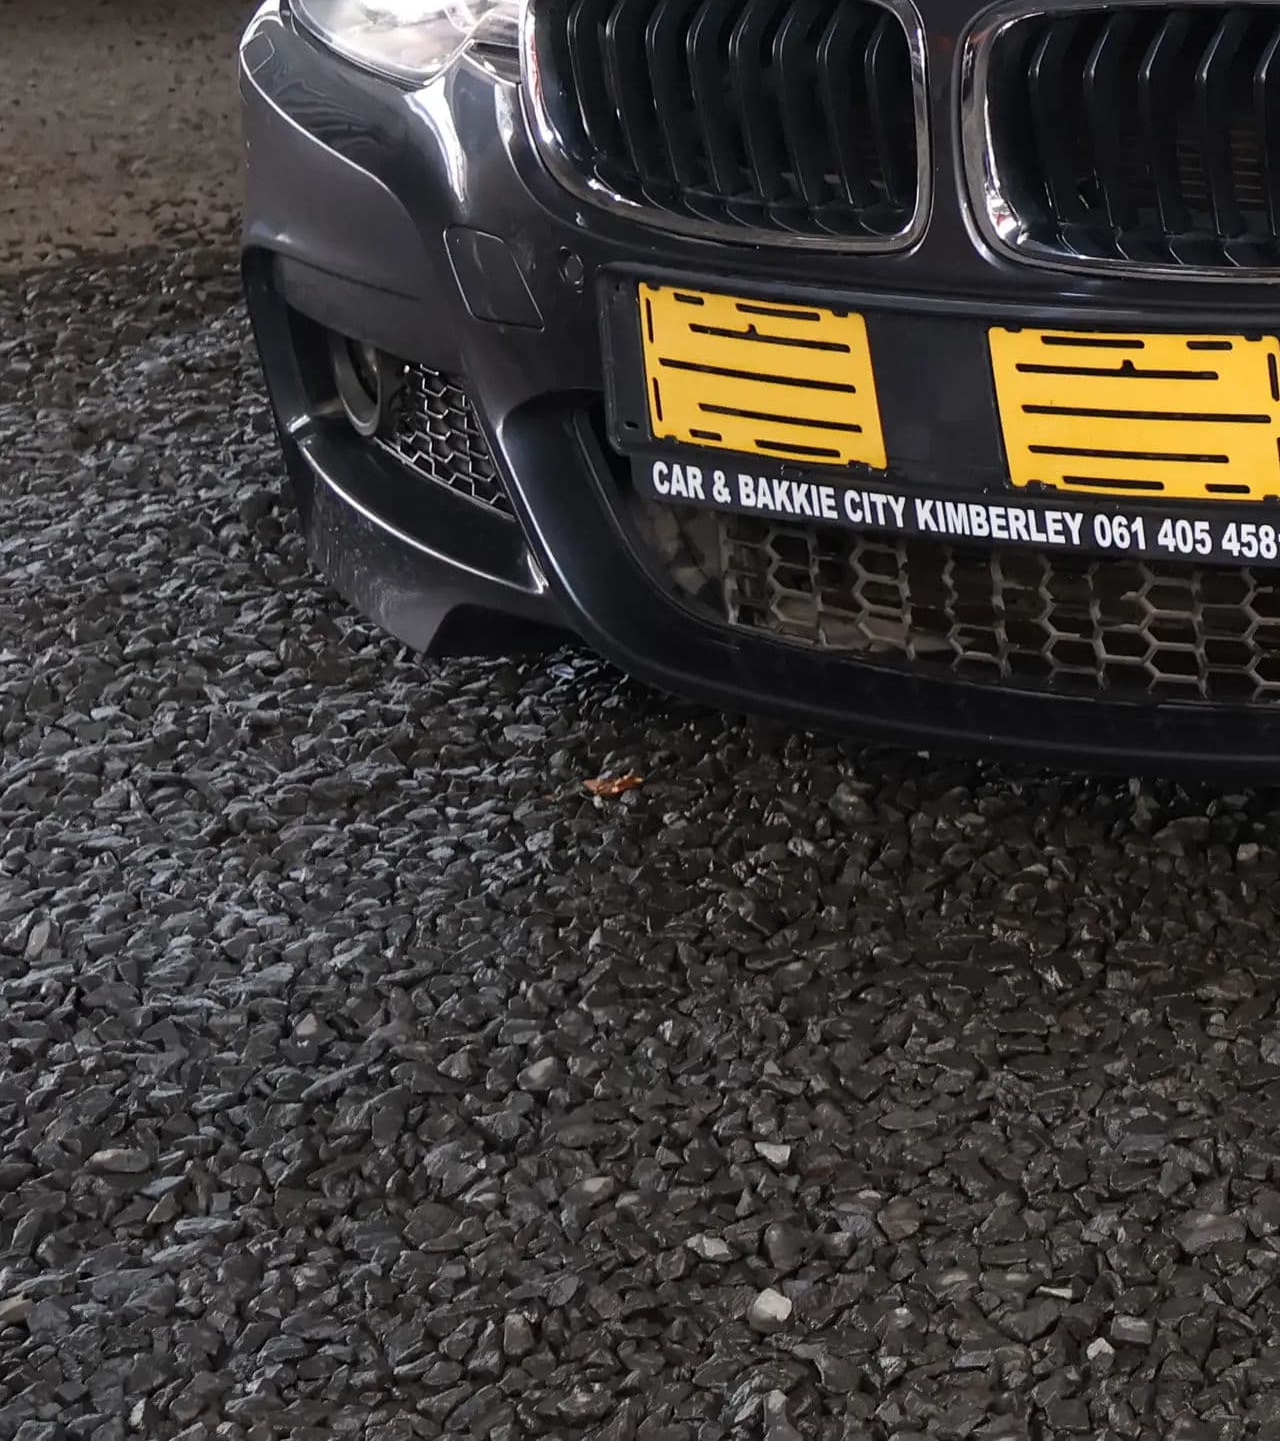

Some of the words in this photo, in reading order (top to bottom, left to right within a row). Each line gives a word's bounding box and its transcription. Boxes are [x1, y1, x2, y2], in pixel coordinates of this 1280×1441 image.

[652, 460, 706, 500] CAR
[712, 469, 732, 504] &
[738, 473, 839, 520] BAKKIE
[844, 489, 906, 528] CITY
[915, 497, 1084, 546] KIMBERLEY
[1093, 513, 1147, 551] 061
[1157, 518, 1212, 556] 405
